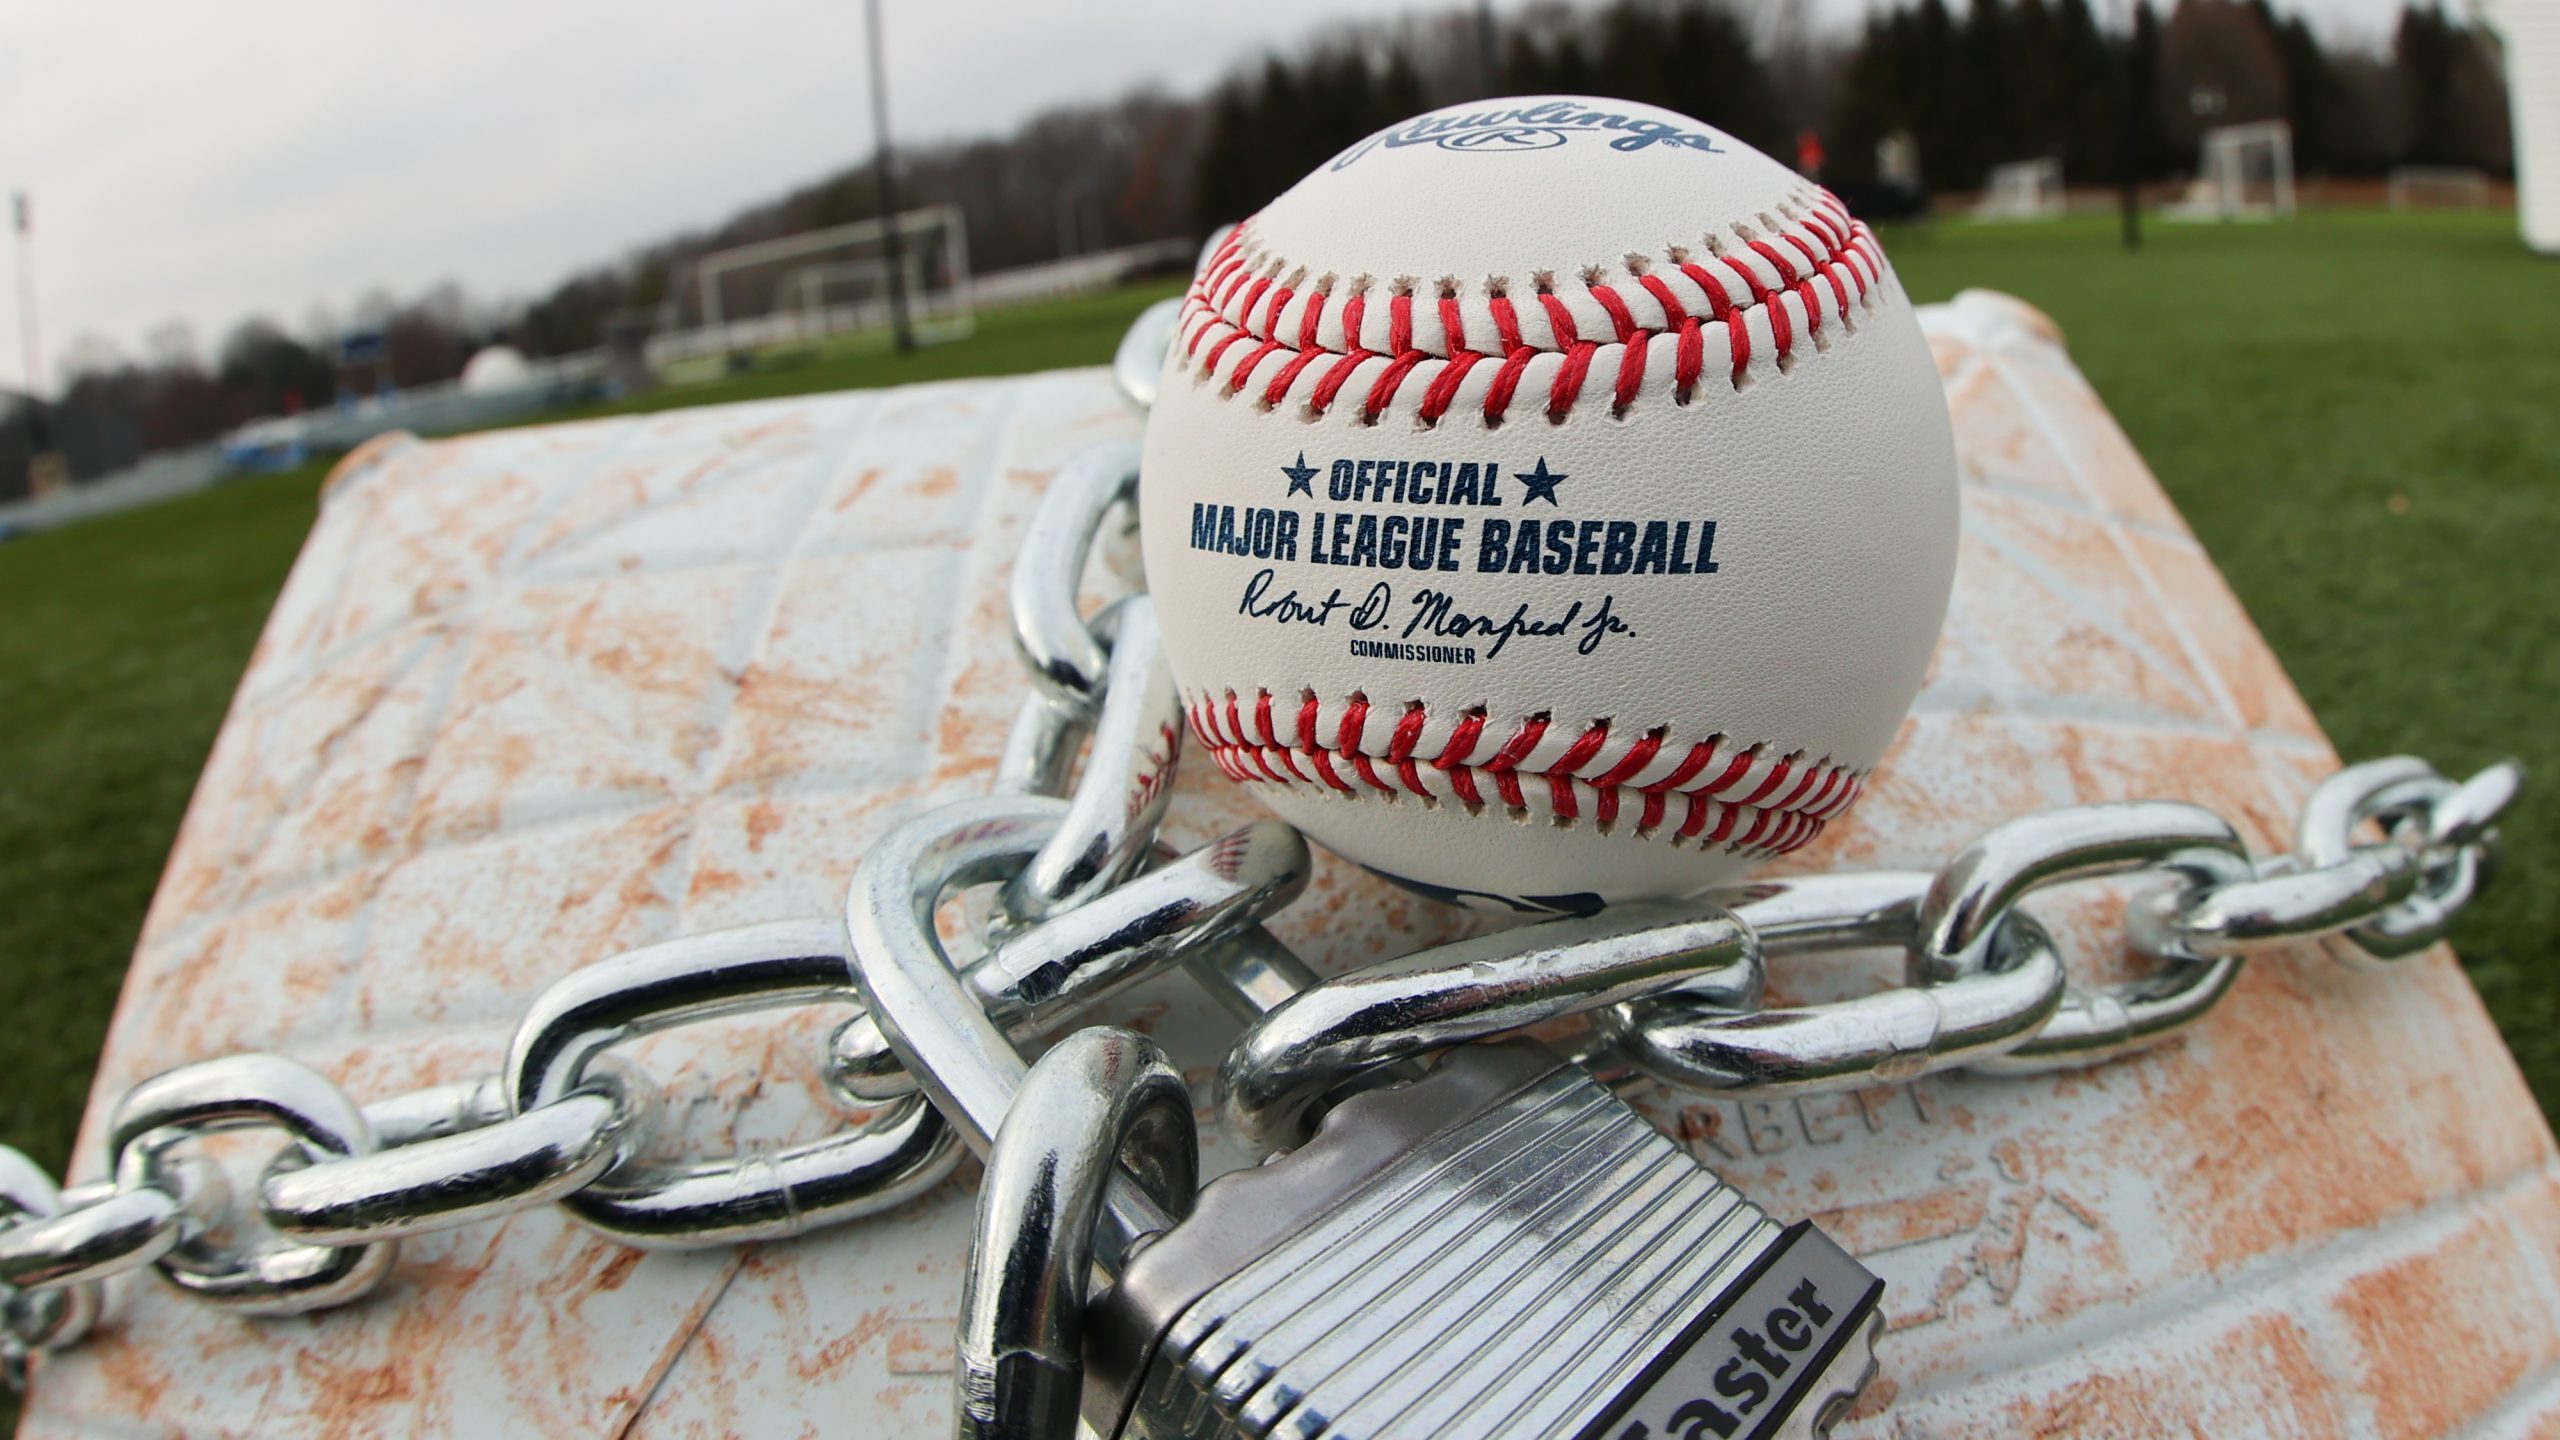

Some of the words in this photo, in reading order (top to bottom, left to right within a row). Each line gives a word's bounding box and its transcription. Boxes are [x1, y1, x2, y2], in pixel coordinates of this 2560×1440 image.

[1331, 102, 1726, 171] Rawlings
[1328, 459, 1502, 505] OFFICIAL
[1190, 503, 1300, 561] MAJOR
[1311, 512, 1465, 572] LEAGUE
[1477, 518, 1719, 575] BASEBALL
[1350, 581, 1389, 630] D.
[1351, 639, 1476, 664] COMMISSIONER
[1616, 1276, 1833, 1440] aster
